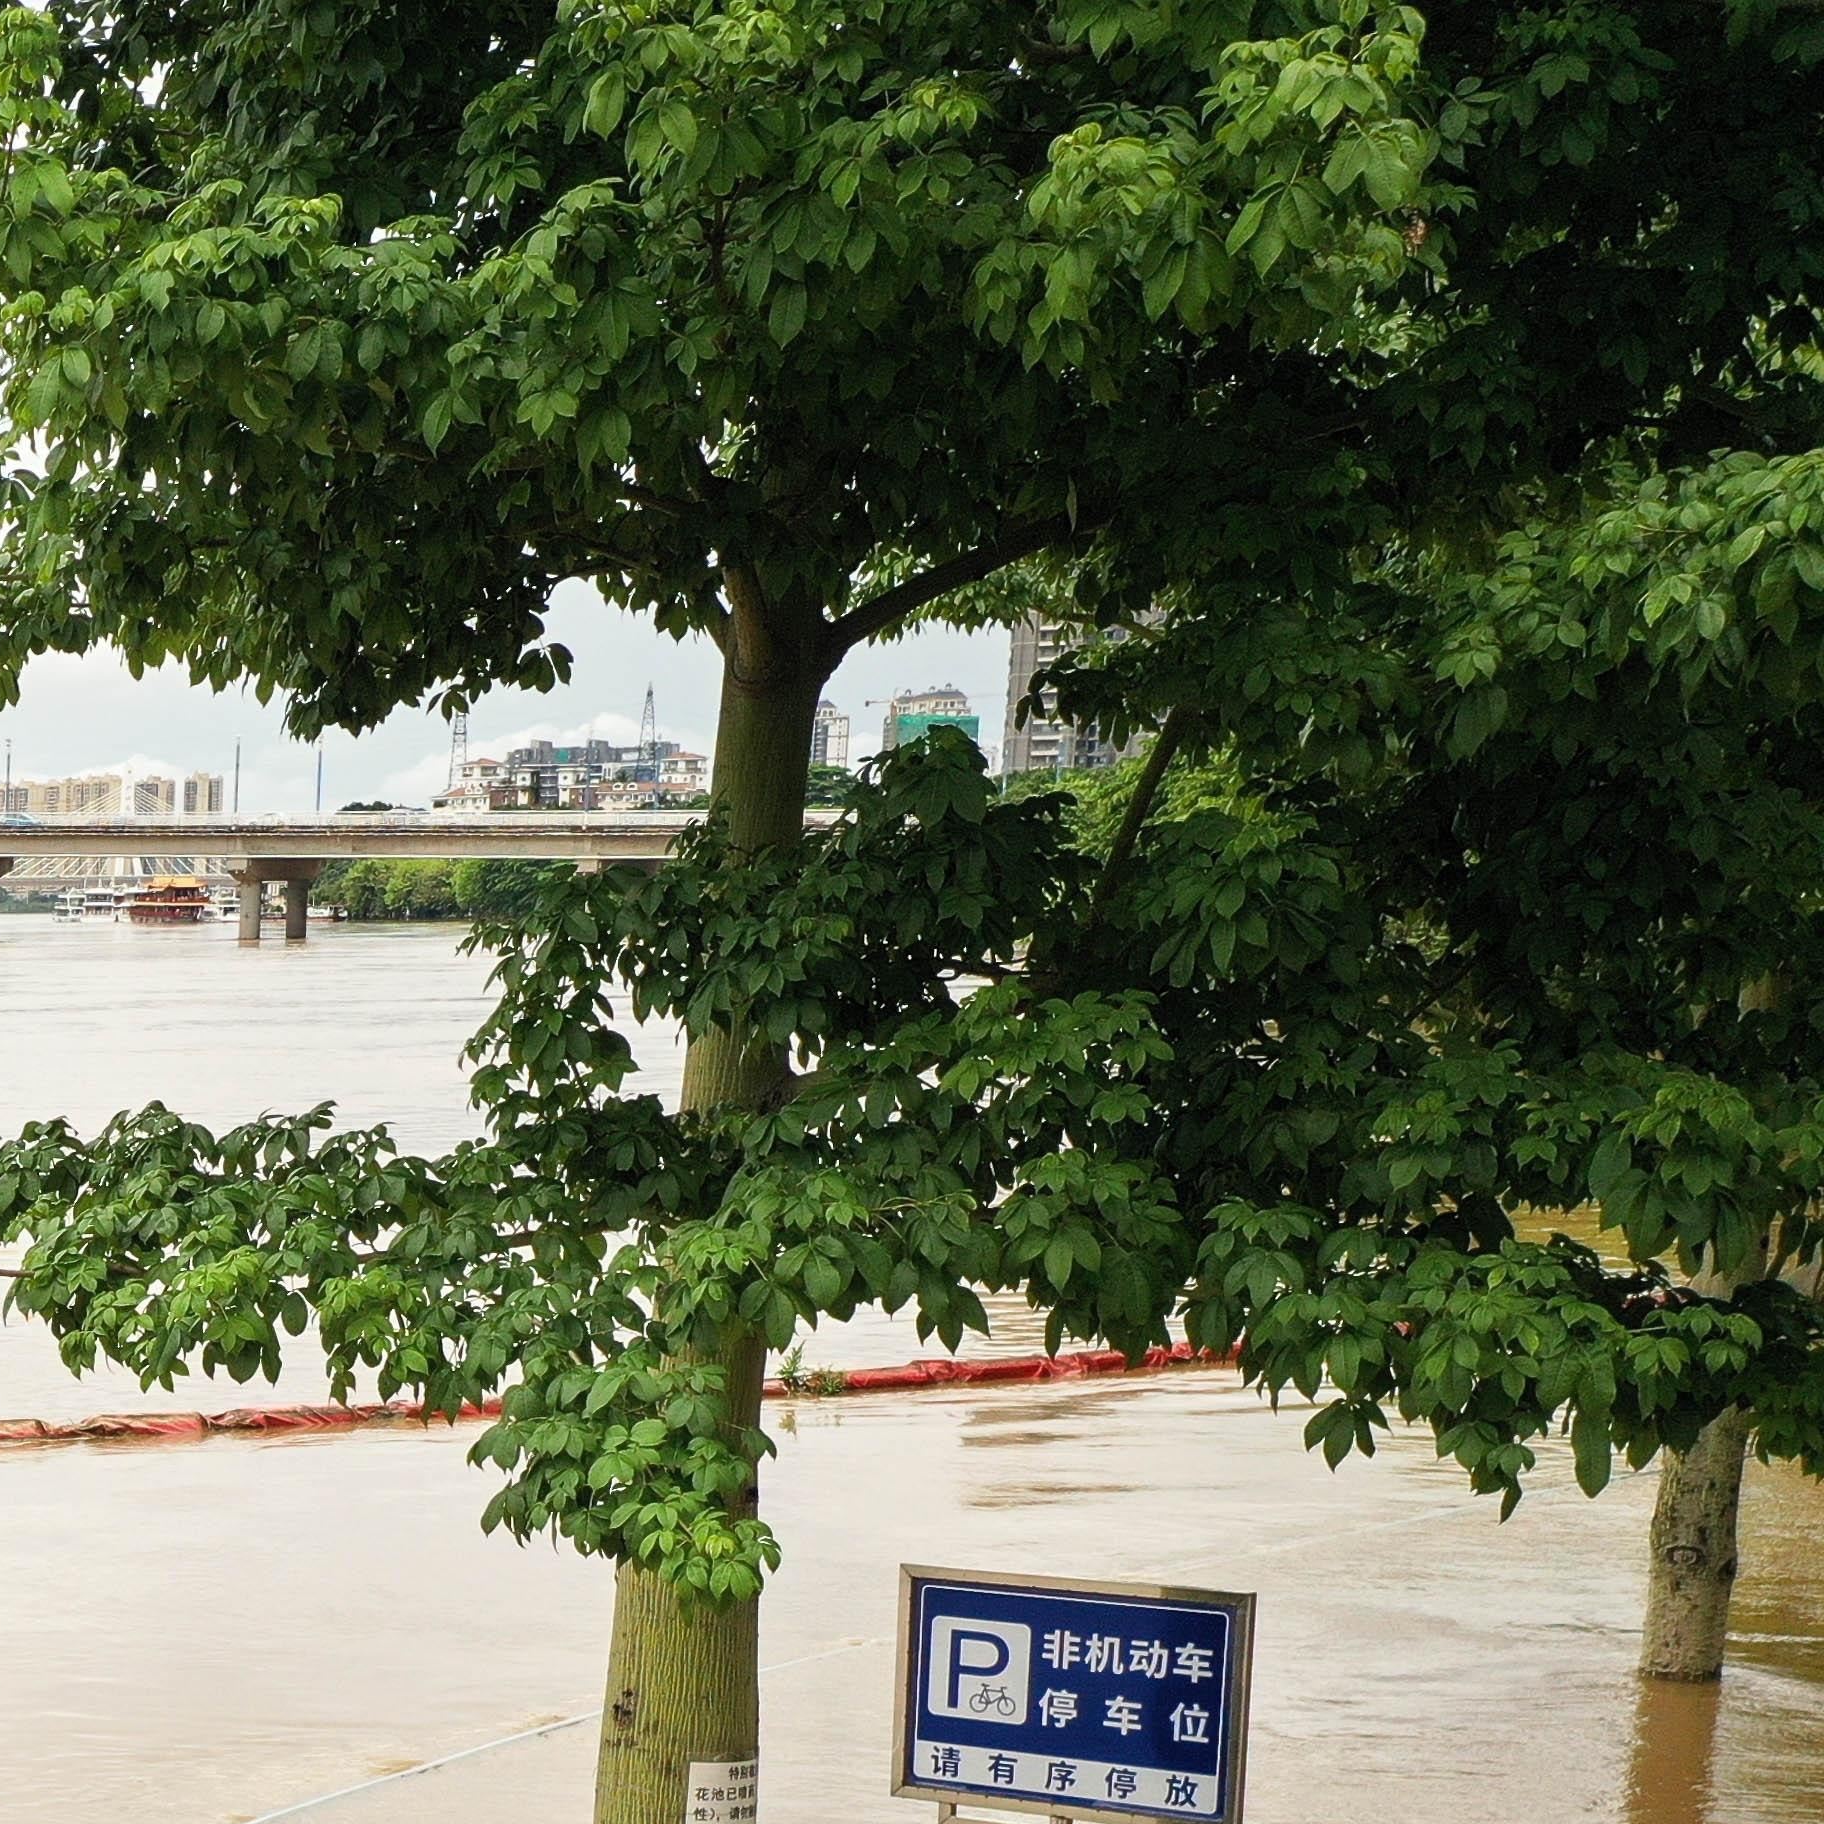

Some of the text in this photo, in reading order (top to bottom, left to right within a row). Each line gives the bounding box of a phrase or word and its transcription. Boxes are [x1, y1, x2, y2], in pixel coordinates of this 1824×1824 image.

[947, 1629, 1010, 1709] P
[1042, 1630, 1214, 1683] 非机动车
[1039, 1688, 1210, 1744] 停车位
[931, 1746, 1199, 1808] 请有序停放
